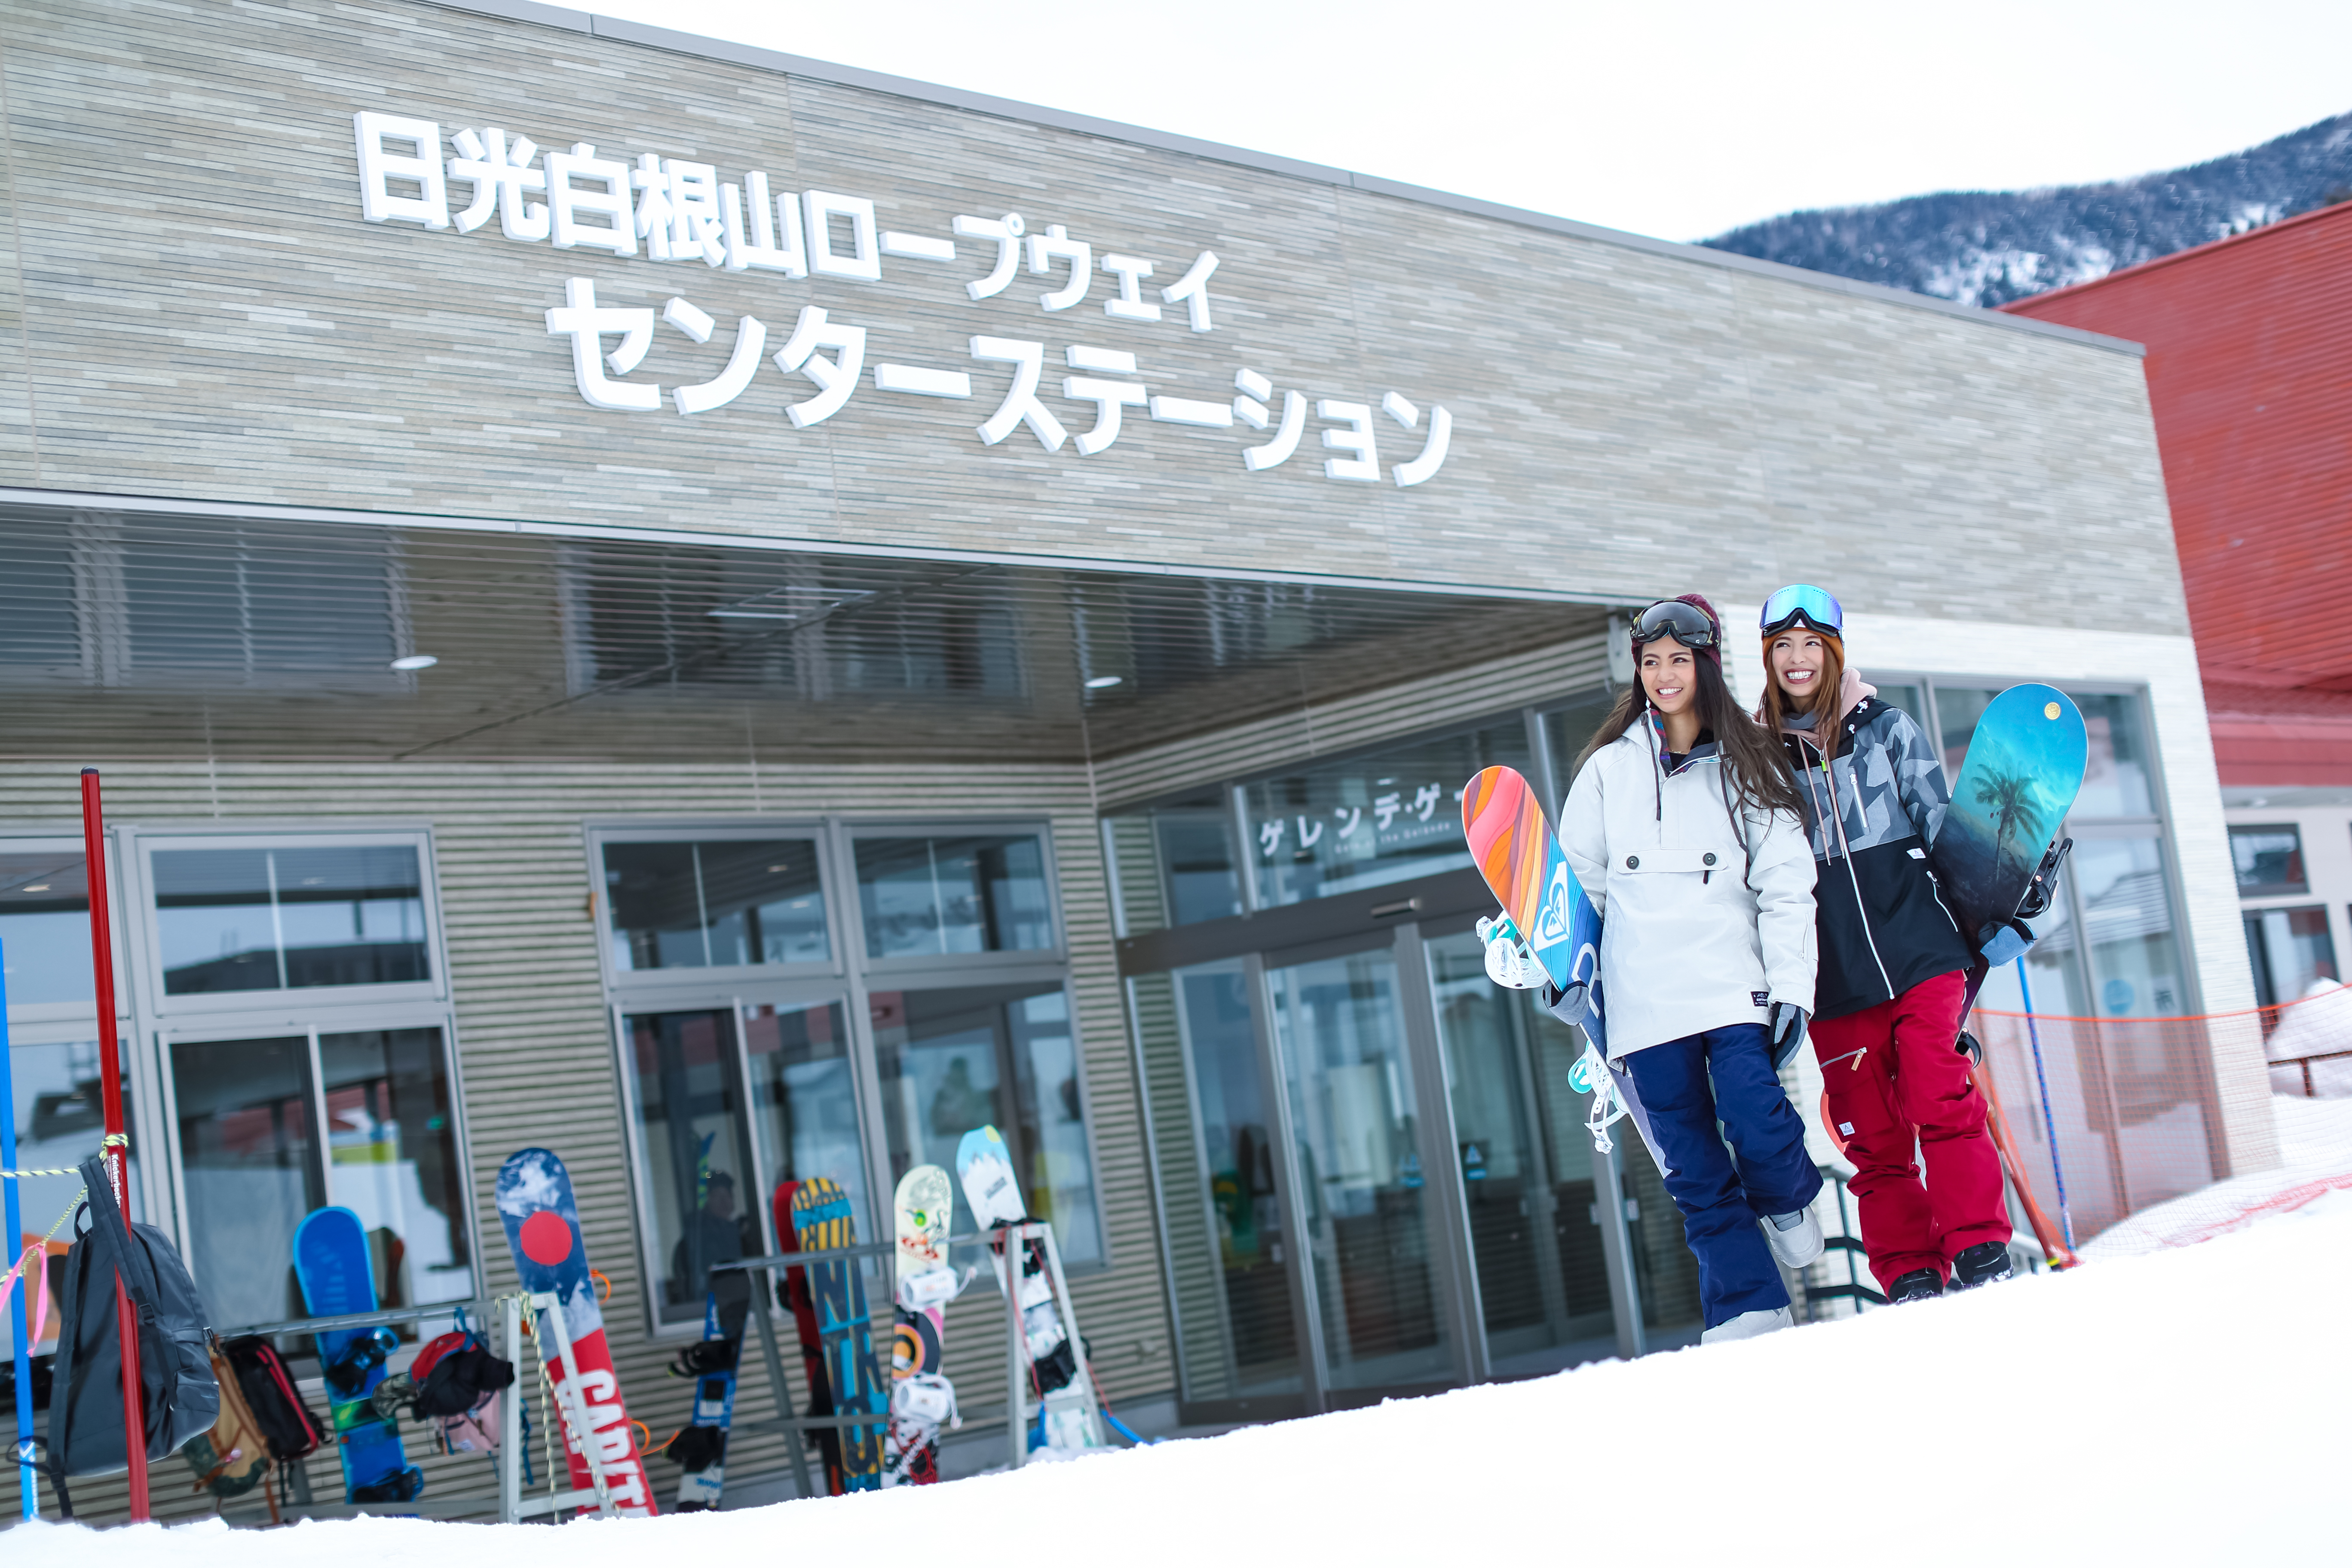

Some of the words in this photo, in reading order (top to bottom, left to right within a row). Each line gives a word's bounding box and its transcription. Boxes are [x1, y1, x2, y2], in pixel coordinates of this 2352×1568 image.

[352, 110, 1220, 333] 日光白根山ロープウェイ
[544, 276, 1453, 487] センターステーション
[1259, 782, 1462, 857] ゲレンデ・ゲ
[111, 1154, 122, 1209] Knickerbocke
[554, 1369, 650, 1519] CAPIT
